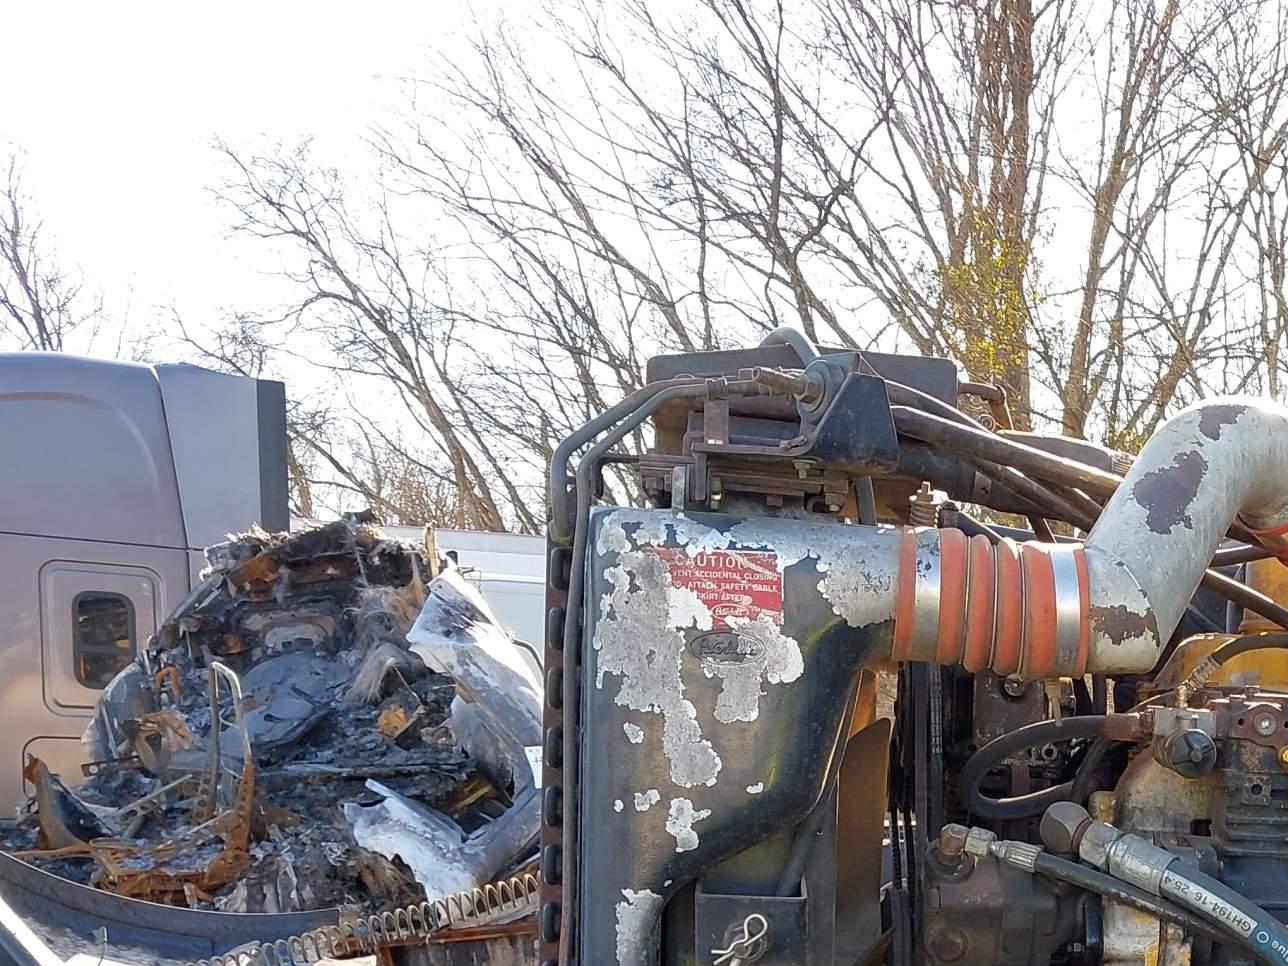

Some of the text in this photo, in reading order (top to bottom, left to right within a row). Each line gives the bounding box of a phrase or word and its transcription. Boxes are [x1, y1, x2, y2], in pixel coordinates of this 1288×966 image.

[694, 570, 741, 580] ACCIDENTAL
[744, 572, 778, 582] CLOSING
[720, 582, 749, 590] SAFETY
[1163, 873, 1190, 896] 25.4
[1193, 888, 1253, 935] GH194-16
